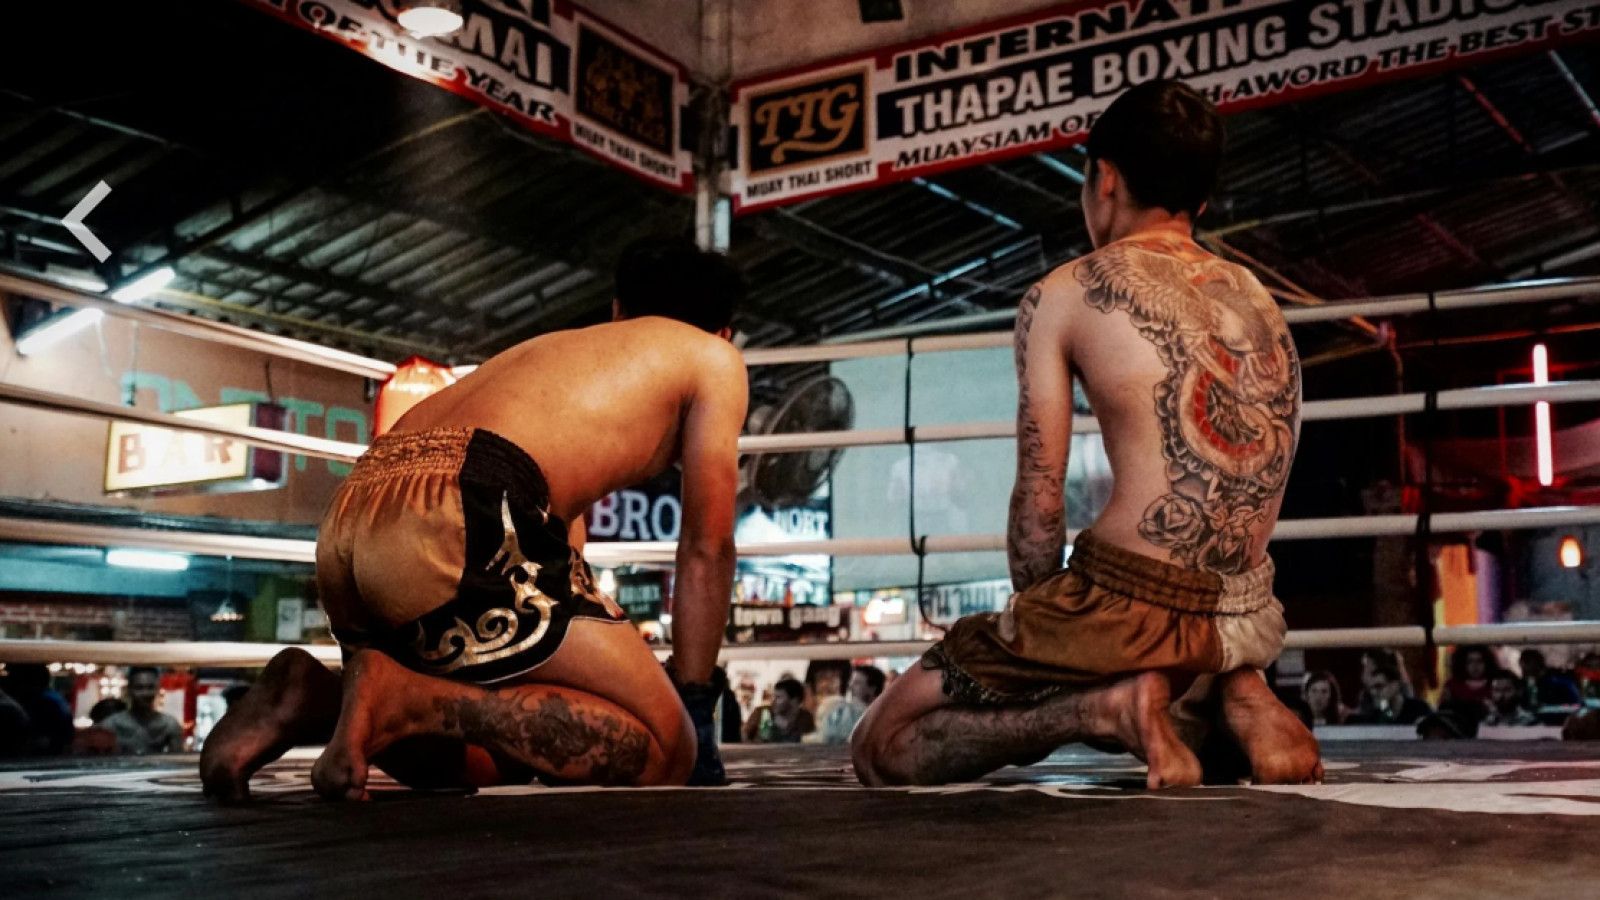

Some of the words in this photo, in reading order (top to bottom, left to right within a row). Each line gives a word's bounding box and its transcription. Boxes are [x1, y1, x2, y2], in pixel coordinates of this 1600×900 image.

[894, 0, 1241, 82] INTERNA
[896, 63, 1074, 138] THAPAE
[1092, 16, 1286, 94] BOXING
[1308, 0, 1520, 44] STAD
[465, 65, 554, 121] YEAR
[755, 83, 859, 164] TTG
[895, 121, 1050, 169] MUAYSIAM
[1061, 111, 1101, 133] OF
[1233, 55, 1368, 98] AWORD
[1378, 37, 1447, 68] THE
[1460, 16, 1552, 53] BEST
[747, 174, 784, 198] MUAY
[788, 169, 820, 190] THAI
[824, 161, 872, 183] SHORT
[118, 431, 234, 474] BAR
